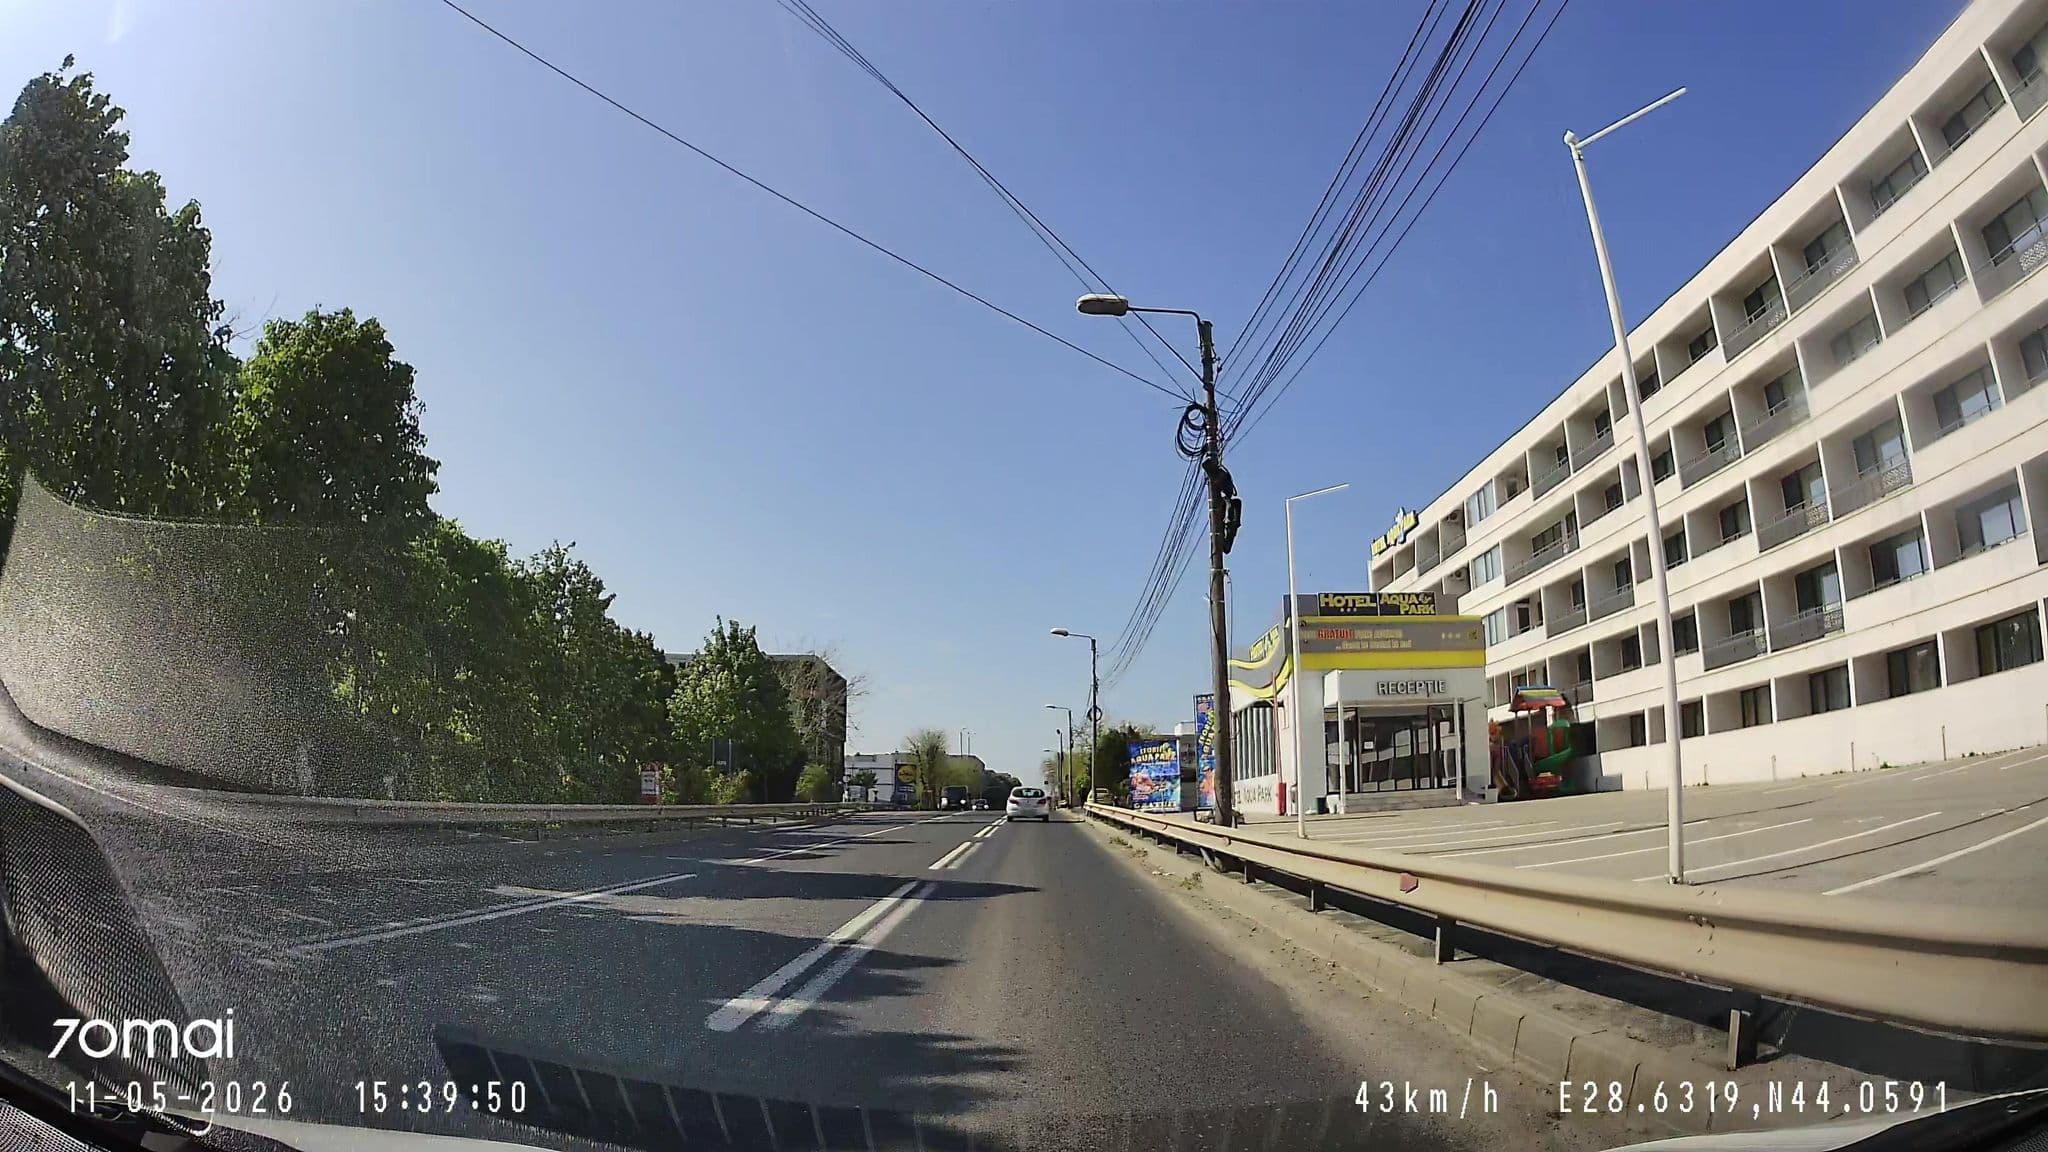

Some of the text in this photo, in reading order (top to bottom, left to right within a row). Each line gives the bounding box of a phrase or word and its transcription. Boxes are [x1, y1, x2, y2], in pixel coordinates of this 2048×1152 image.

[1320, 592, 1418, 607] HOTEL AQUA
[1400, 604, 1435, 614] PARK
